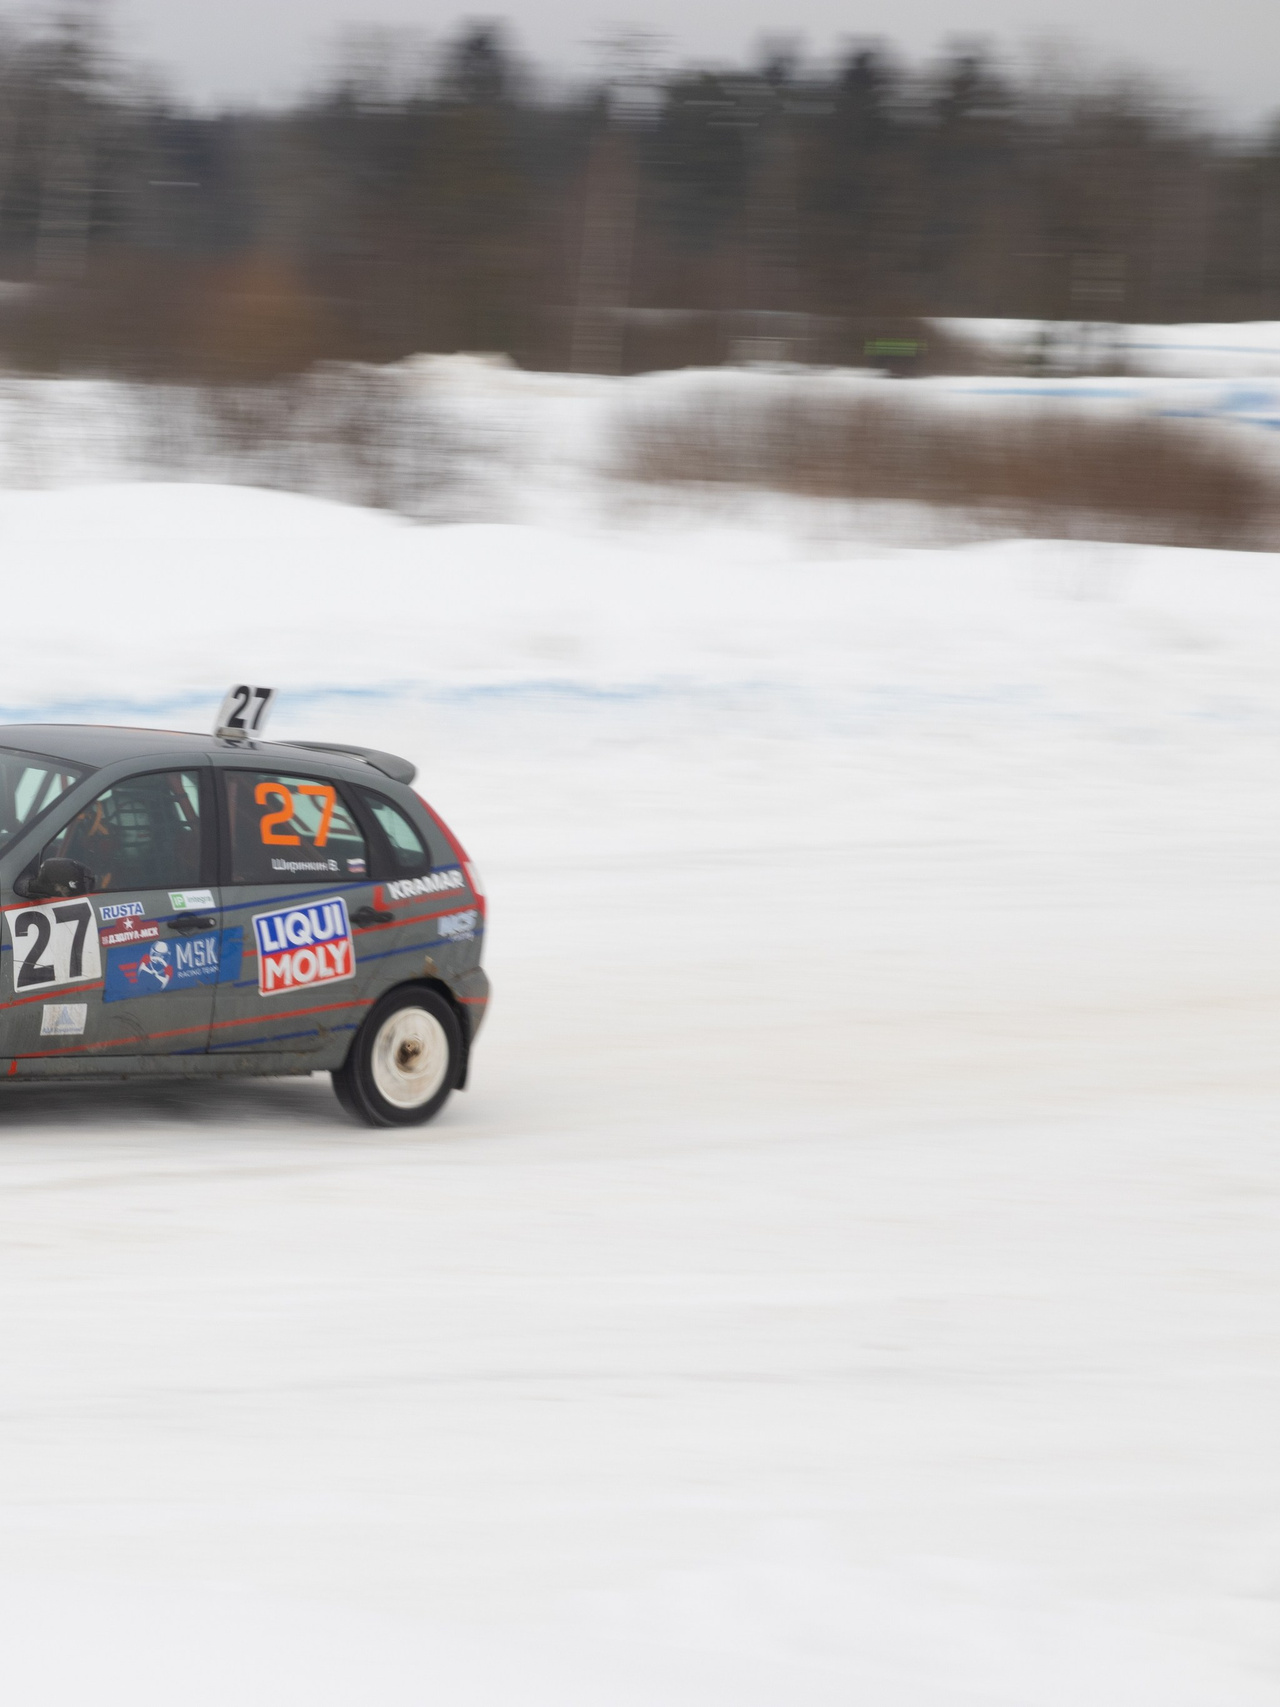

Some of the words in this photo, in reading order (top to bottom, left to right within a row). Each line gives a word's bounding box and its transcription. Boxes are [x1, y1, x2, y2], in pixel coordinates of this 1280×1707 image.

[227, 685, 273, 730] 27
[254, 782, 337, 847] 27
[386, 870, 465, 900] KRAMAR
[102, 903, 143, 919] RUSTA
[259, 903, 345, 952] LIQUI
[15, 902, 92, 988] 27
[175, 937, 219, 970] MSK
[264, 940, 348, 989] MOLY
